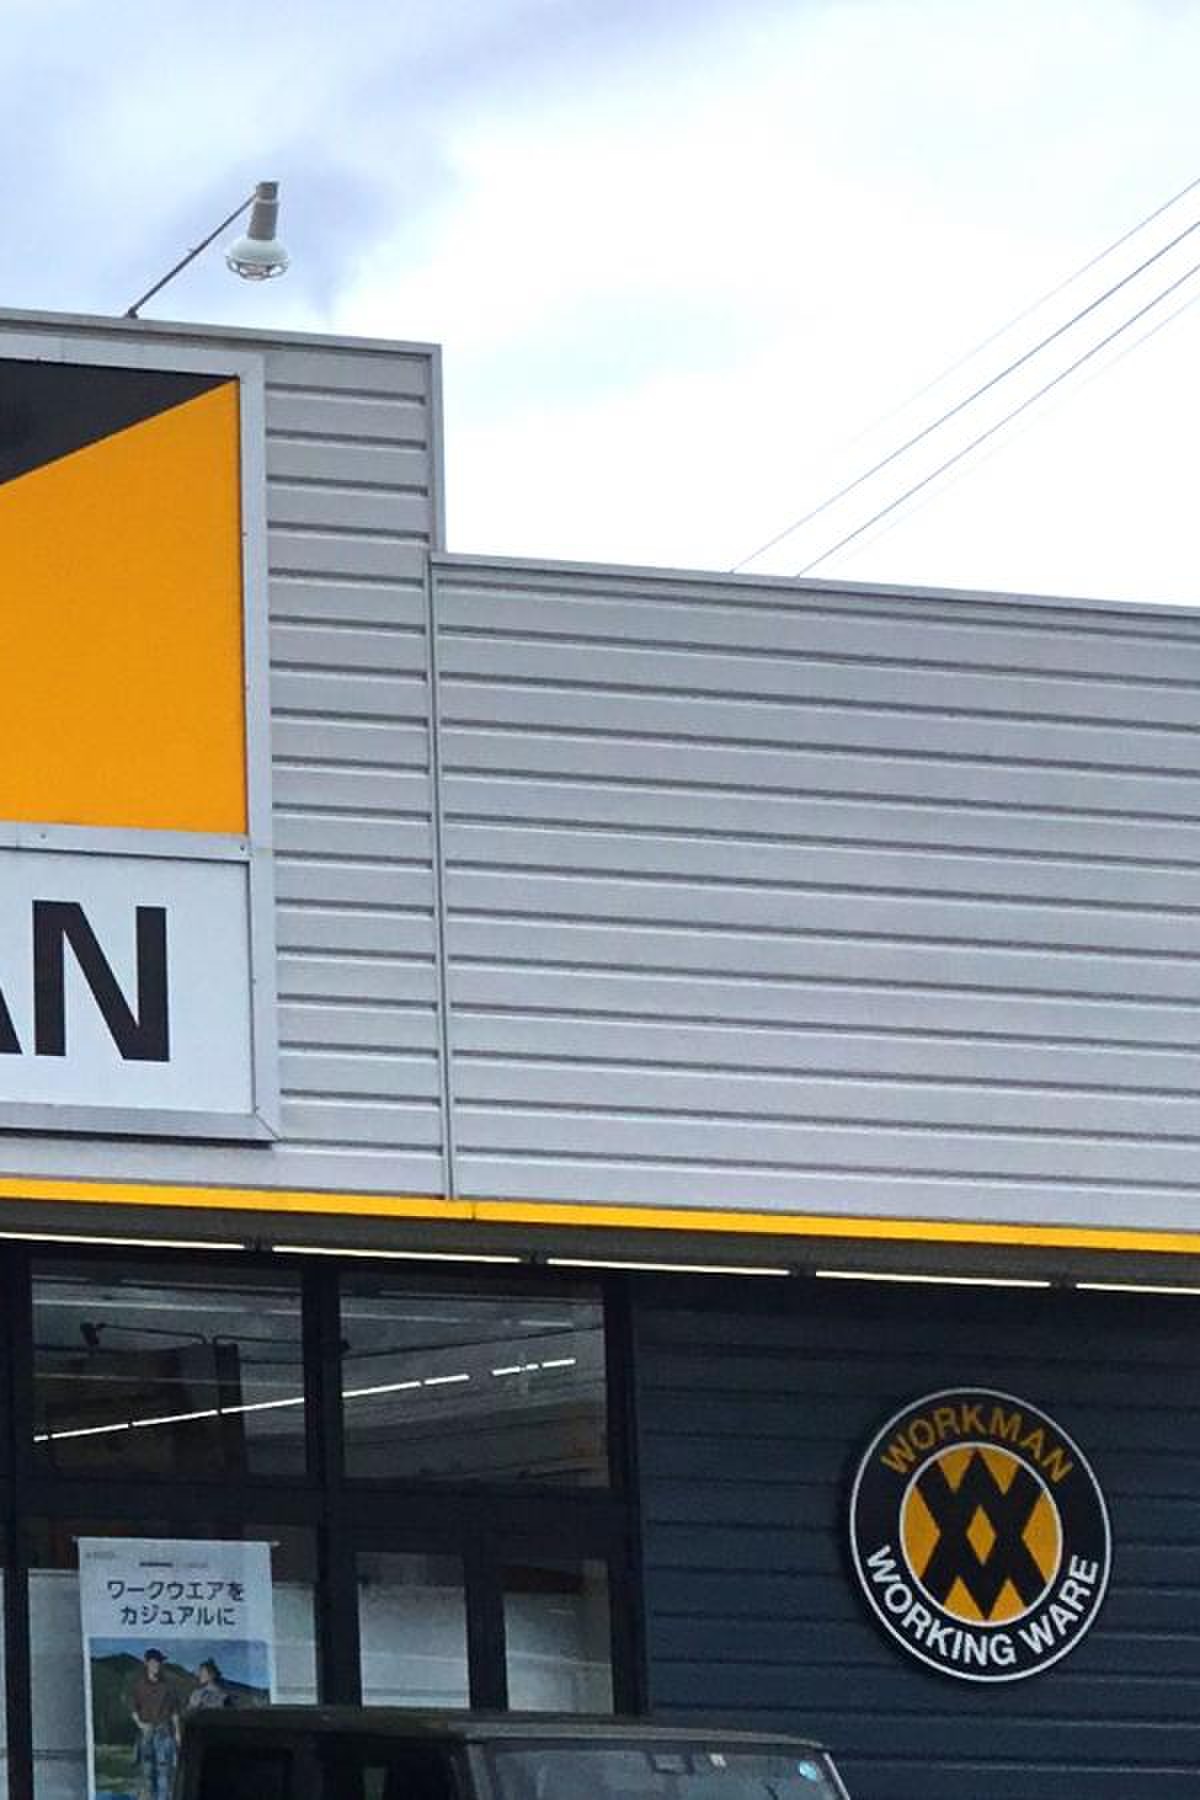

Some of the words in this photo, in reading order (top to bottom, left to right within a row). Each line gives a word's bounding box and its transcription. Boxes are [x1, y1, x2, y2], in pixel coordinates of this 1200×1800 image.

[880, 1403, 1073, 1484] WORKMAN
[107, 1581, 244, 1601] ワークウエアを
[121, 1605, 236, 1626] カジュアルに
[867, 1545, 1016, 1666] WORKING
[1019, 1555, 1099, 1654] WARE
